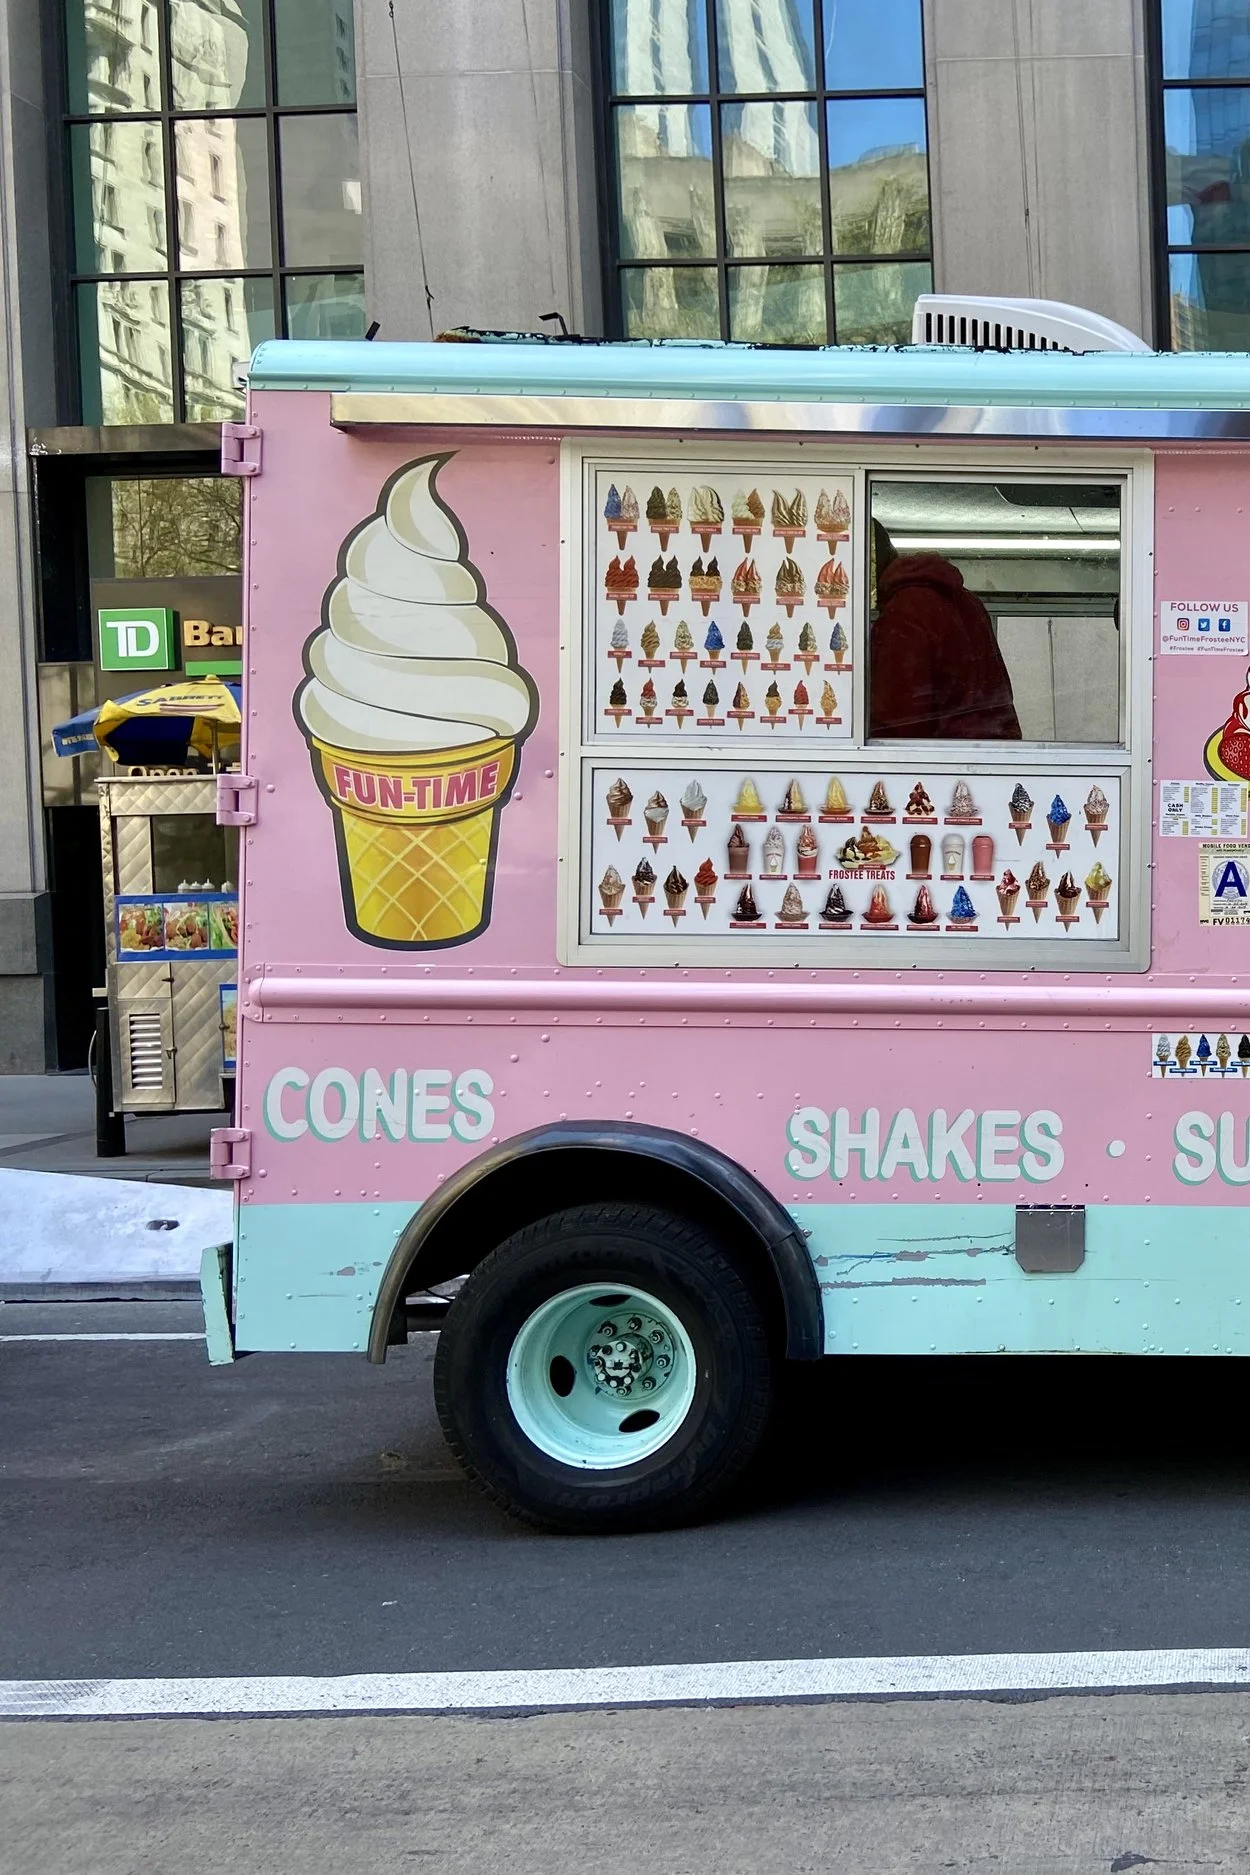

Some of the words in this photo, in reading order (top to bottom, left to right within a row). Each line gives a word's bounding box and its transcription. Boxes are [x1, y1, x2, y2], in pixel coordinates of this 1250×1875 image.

[1170, 602, 1221, 612] FOLLOW
[1223, 603, 1239, 612] US
[106, 621, 159, 657] TD
[183, 619, 242, 647] Ba
[1162, 635, 1245, 643] @FunTimeFrosteeNYC
[333, 760, 500, 811] FUN-TIME
[829, 870, 863, 880] FROSTEE
[867, 870, 895, 880] TREATS
[1215, 862, 1247, 897] A
[264, 1065, 495, 1143] CONES
[787, 1107, 1064, 1184] SHAKES
